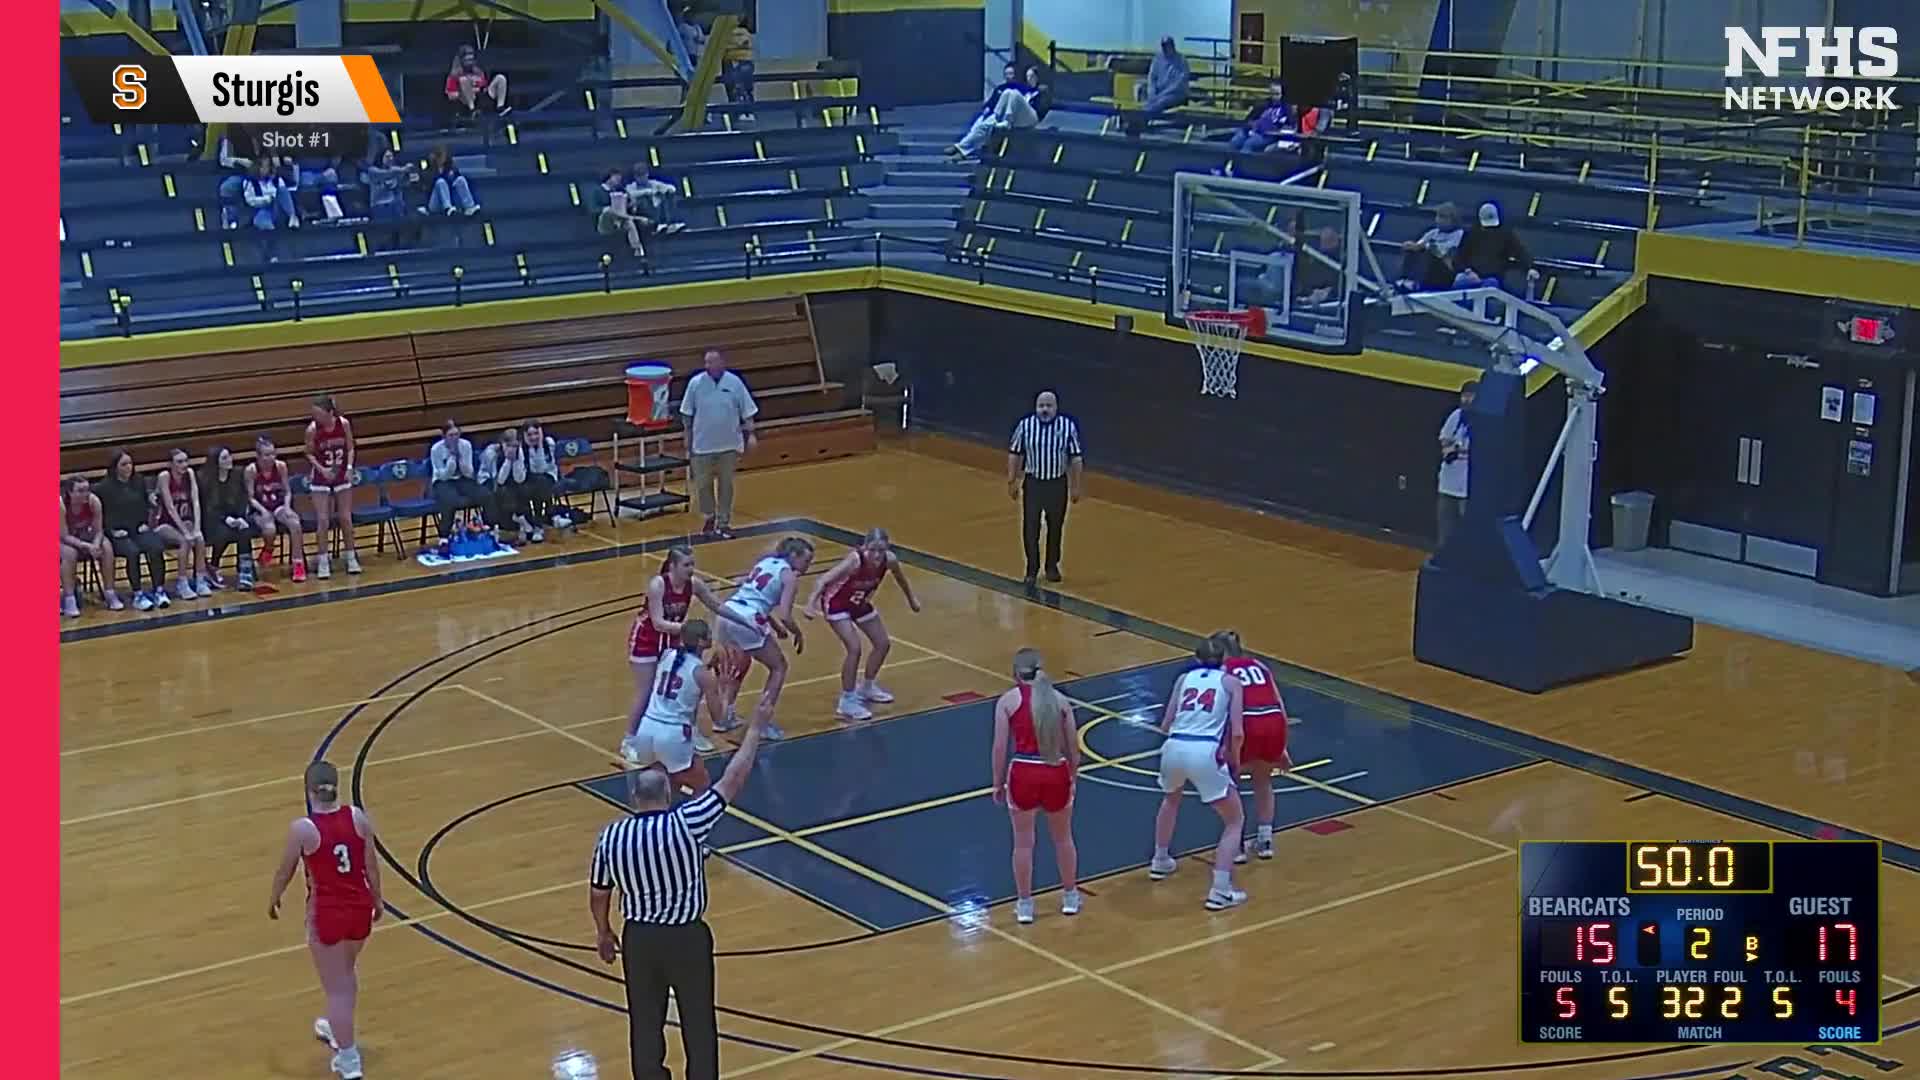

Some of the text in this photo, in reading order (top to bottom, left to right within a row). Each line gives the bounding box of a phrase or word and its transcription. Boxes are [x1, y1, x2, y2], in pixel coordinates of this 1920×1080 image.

[325, 448, 344, 465] 32
[1233, 665, 1266, 686] 30
[1181, 688, 1217, 713] 24
[333, 844, 351, 873] 3
